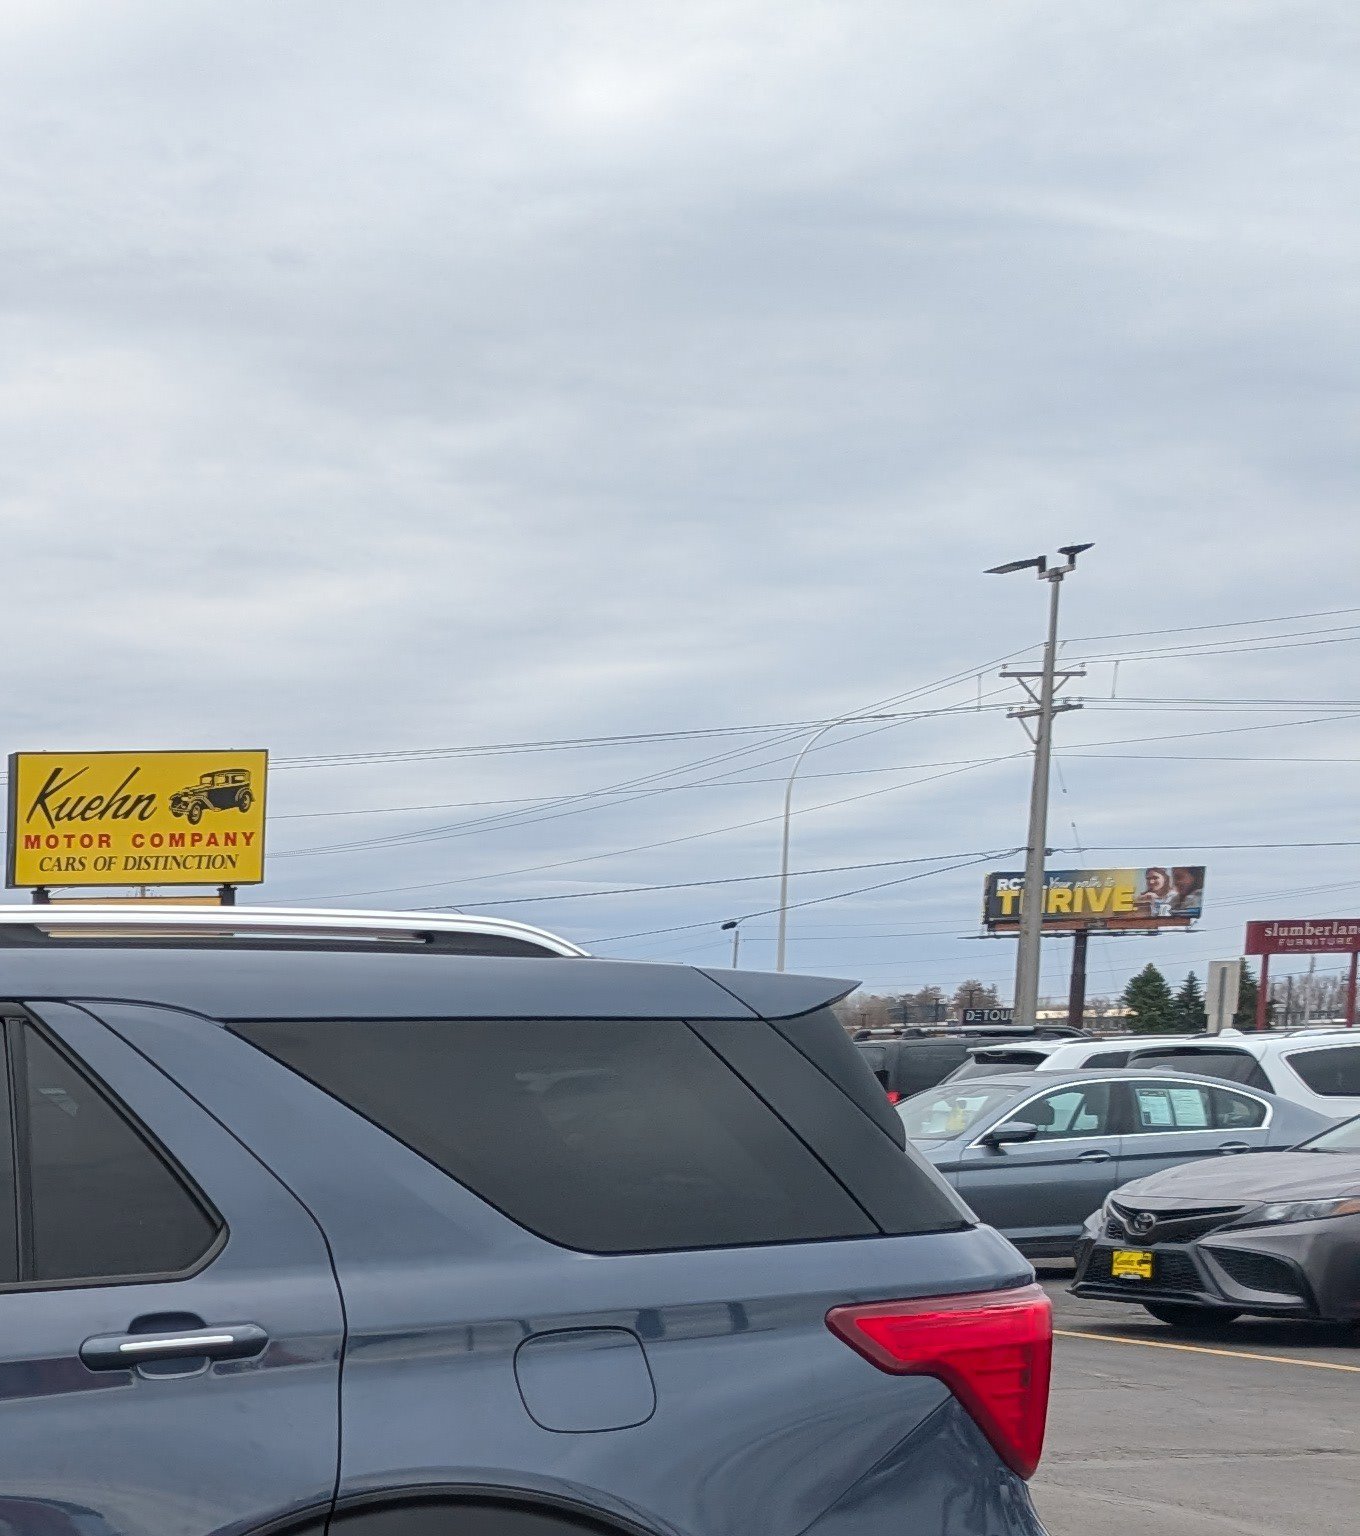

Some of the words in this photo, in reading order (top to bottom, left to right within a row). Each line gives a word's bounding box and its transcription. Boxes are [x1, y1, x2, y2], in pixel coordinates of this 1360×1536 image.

[25, 765, 157, 829] Kuehn
[23, 833, 112, 850] MOTOR
[131, 831, 257, 849] COMPANY
[38, 856, 87, 873] CARS
[93, 855, 118, 872] OF
[121, 853, 240, 872] DISTINCTION
[1264, 921, 1360, 937] slumberlan
